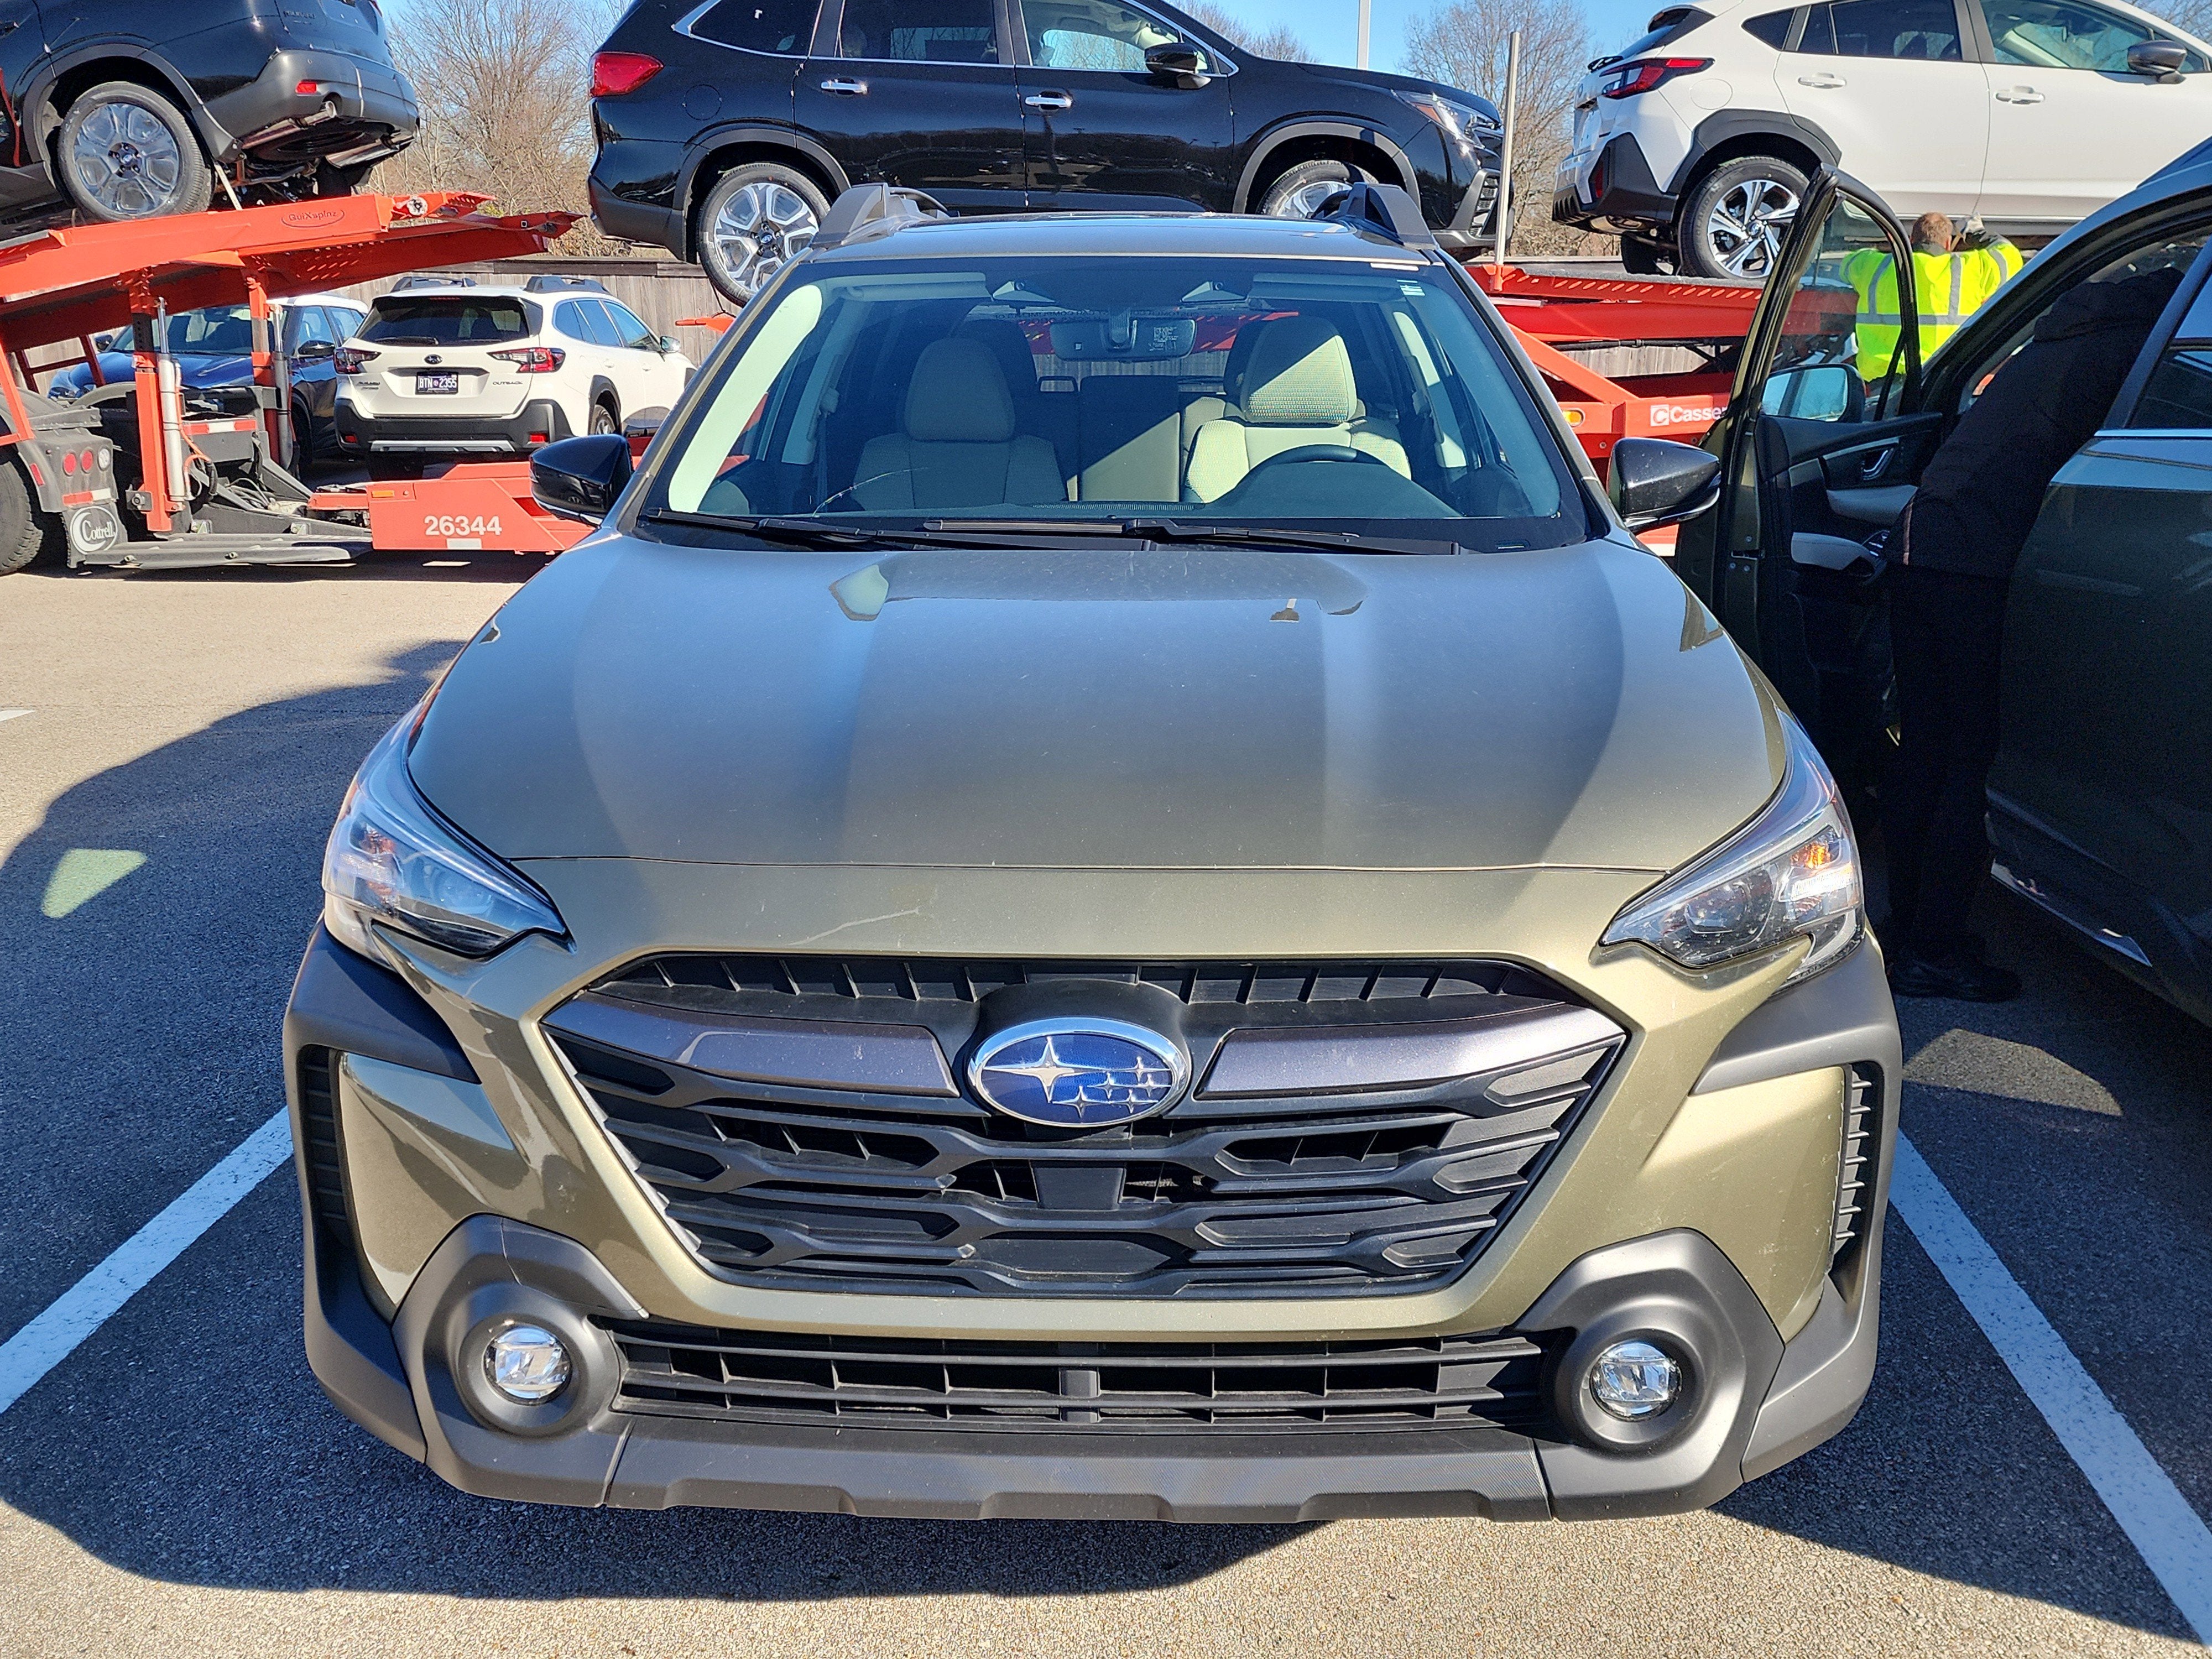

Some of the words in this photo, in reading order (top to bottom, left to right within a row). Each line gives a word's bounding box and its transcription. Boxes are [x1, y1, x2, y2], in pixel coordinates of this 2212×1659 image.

[419, 378, 433, 388] BTN
[439, 377, 457, 388] 2355
[82, 520, 115, 541] Cottrell
[424, 515, 503, 536] 26344
